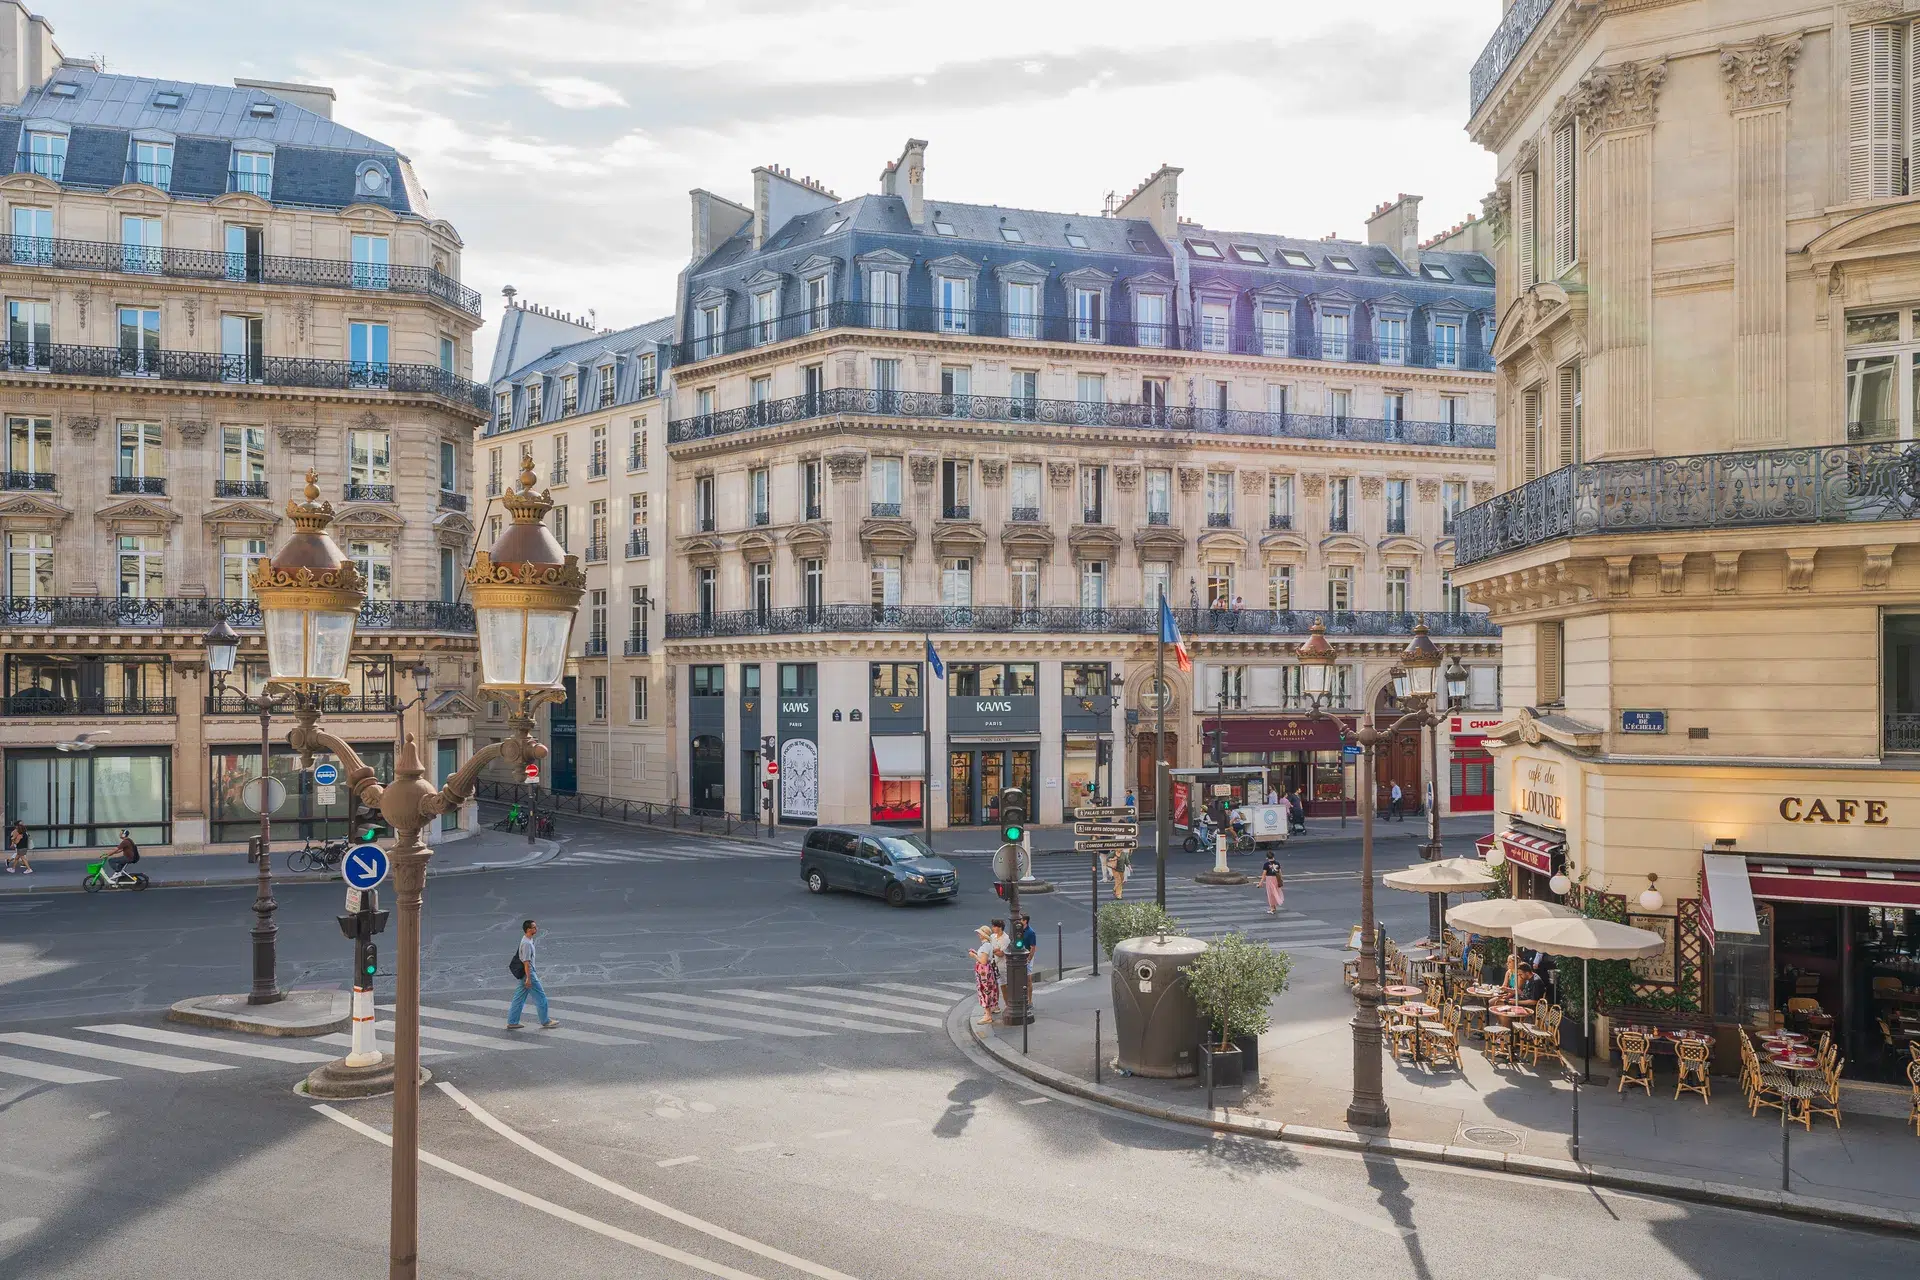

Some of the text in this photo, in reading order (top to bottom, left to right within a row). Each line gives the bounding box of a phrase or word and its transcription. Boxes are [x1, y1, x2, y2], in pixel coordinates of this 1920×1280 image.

[783, 702, 809, 713] KAMS
[976, 702, 1011, 712] KAMS
[1470, 720, 1503, 728] CHAN
[1528, 763, 1555, 787] café du
[1522, 788, 1561, 820] LOUVRE
[1779, 797, 1889, 825] CAFE
[1521, 850, 1539, 866] LOUVRE
